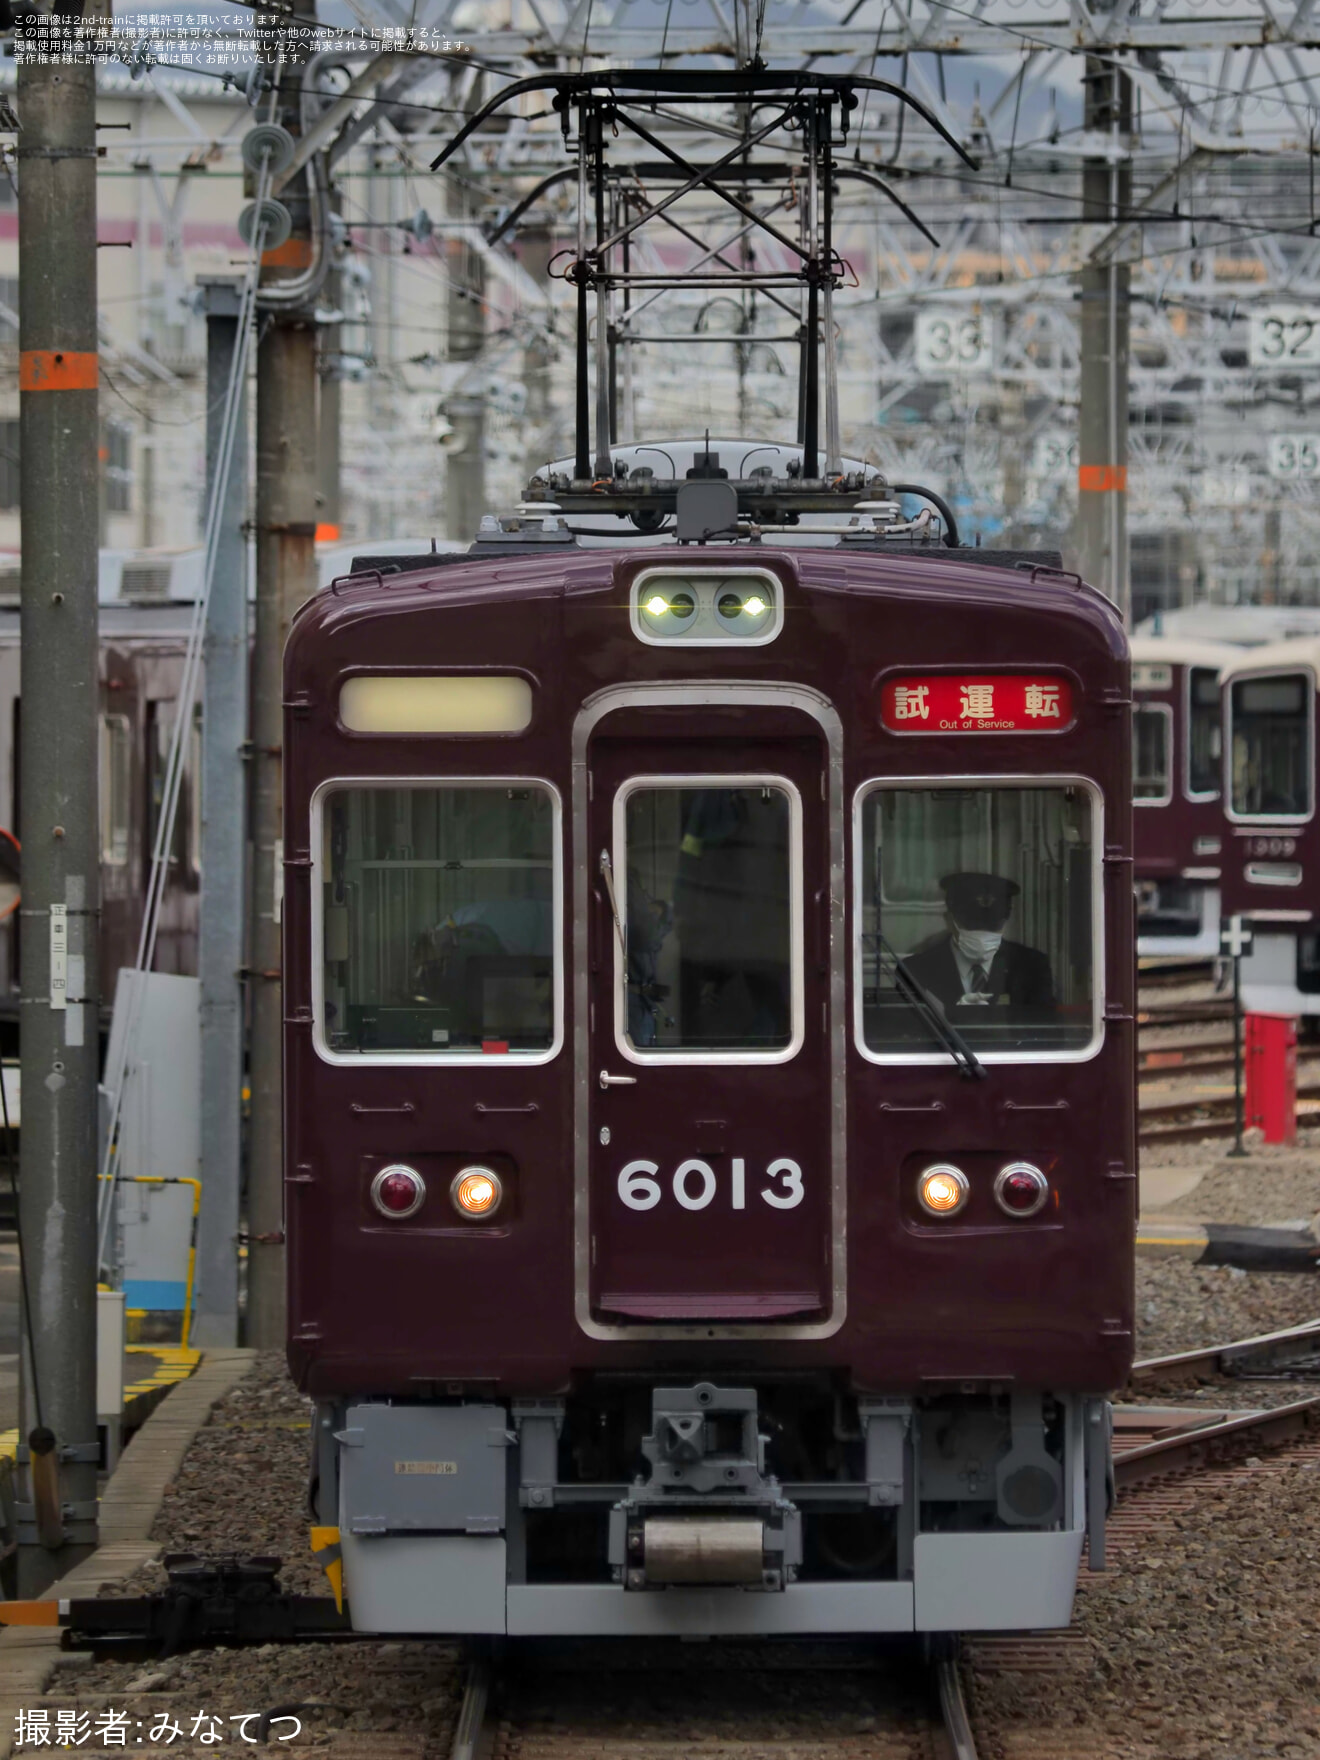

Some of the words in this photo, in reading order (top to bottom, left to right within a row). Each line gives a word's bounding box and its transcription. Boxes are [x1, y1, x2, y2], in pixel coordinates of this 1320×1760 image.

[928, 319, 980, 363] 33
[1261, 317, 1315, 358] 32
[1278, 439, 1318, 471] 35
[894, 684, 1060, 719] 試運転
[939, 719, 958, 729] Out
[962, 719, 973, 729] of
[977, 719, 1015, 729] Service
[617, 1158, 805, 1211] 6013
